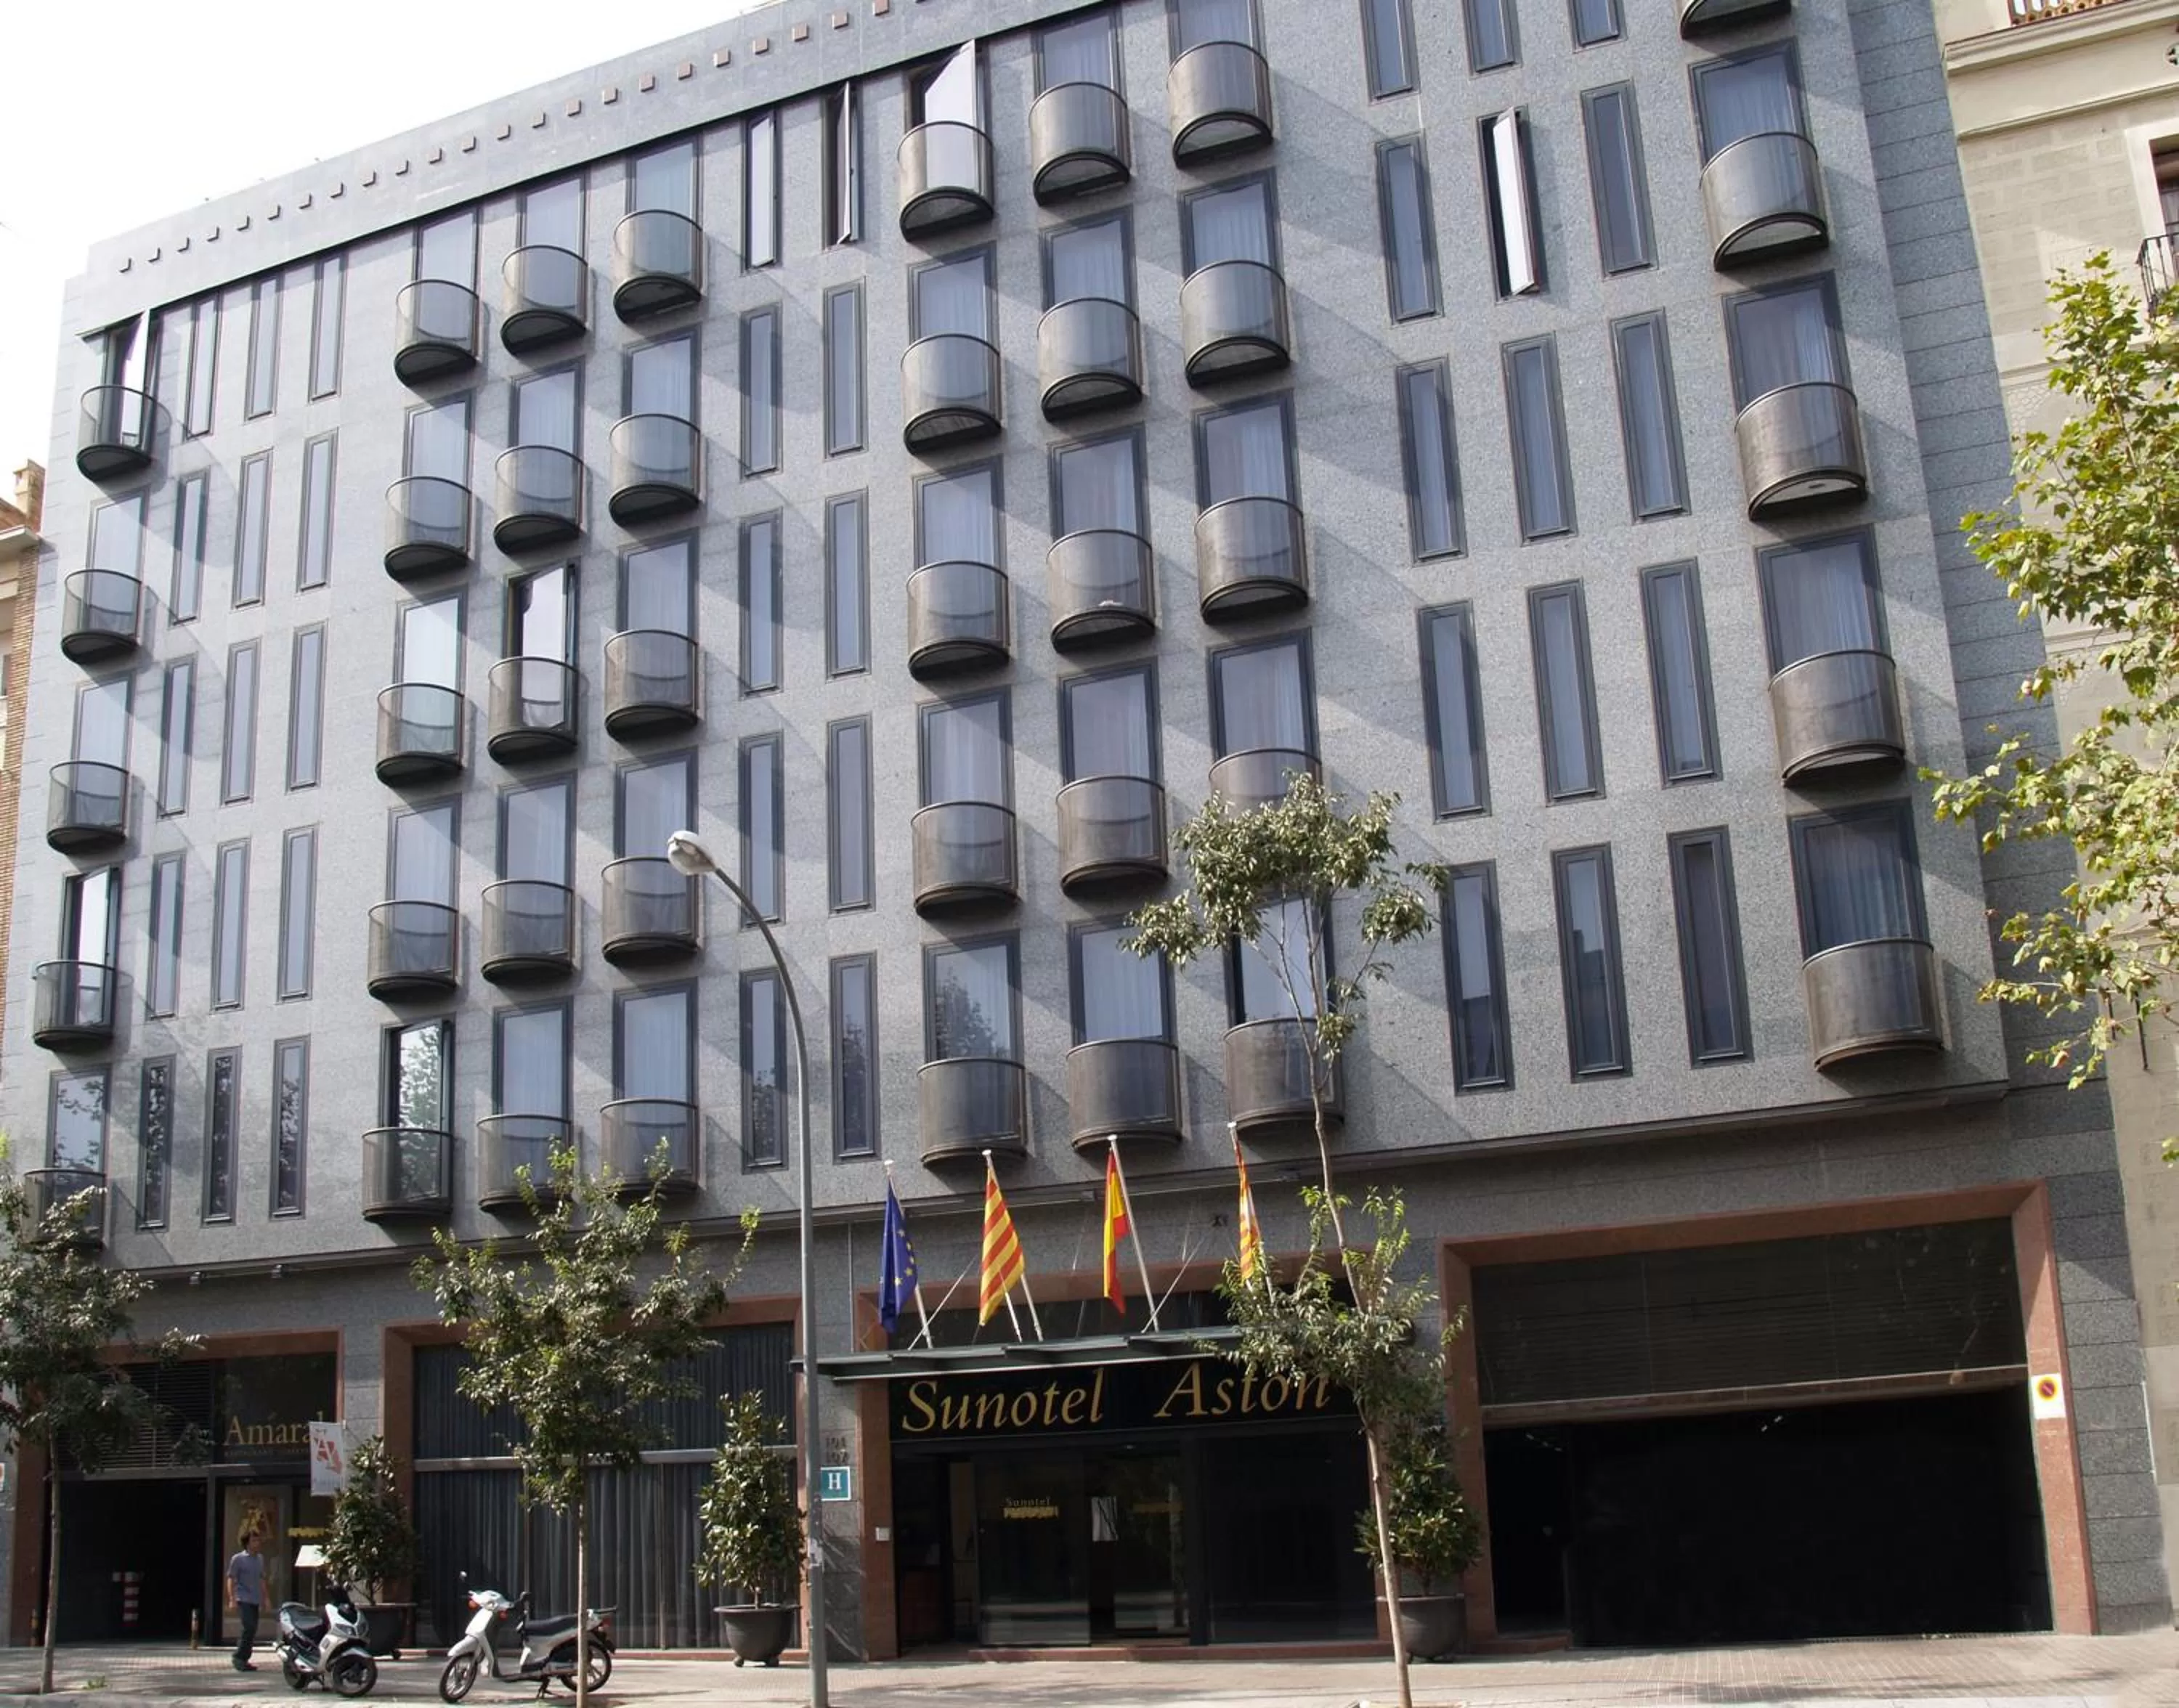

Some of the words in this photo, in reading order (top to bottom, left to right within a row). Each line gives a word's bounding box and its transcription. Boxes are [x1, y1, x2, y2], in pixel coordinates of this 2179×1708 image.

[902, 1367, 1105, 1432] Sunotel
[1153, 1362, 1331, 1418] Aston
[828, 1472, 843, 1490] H
